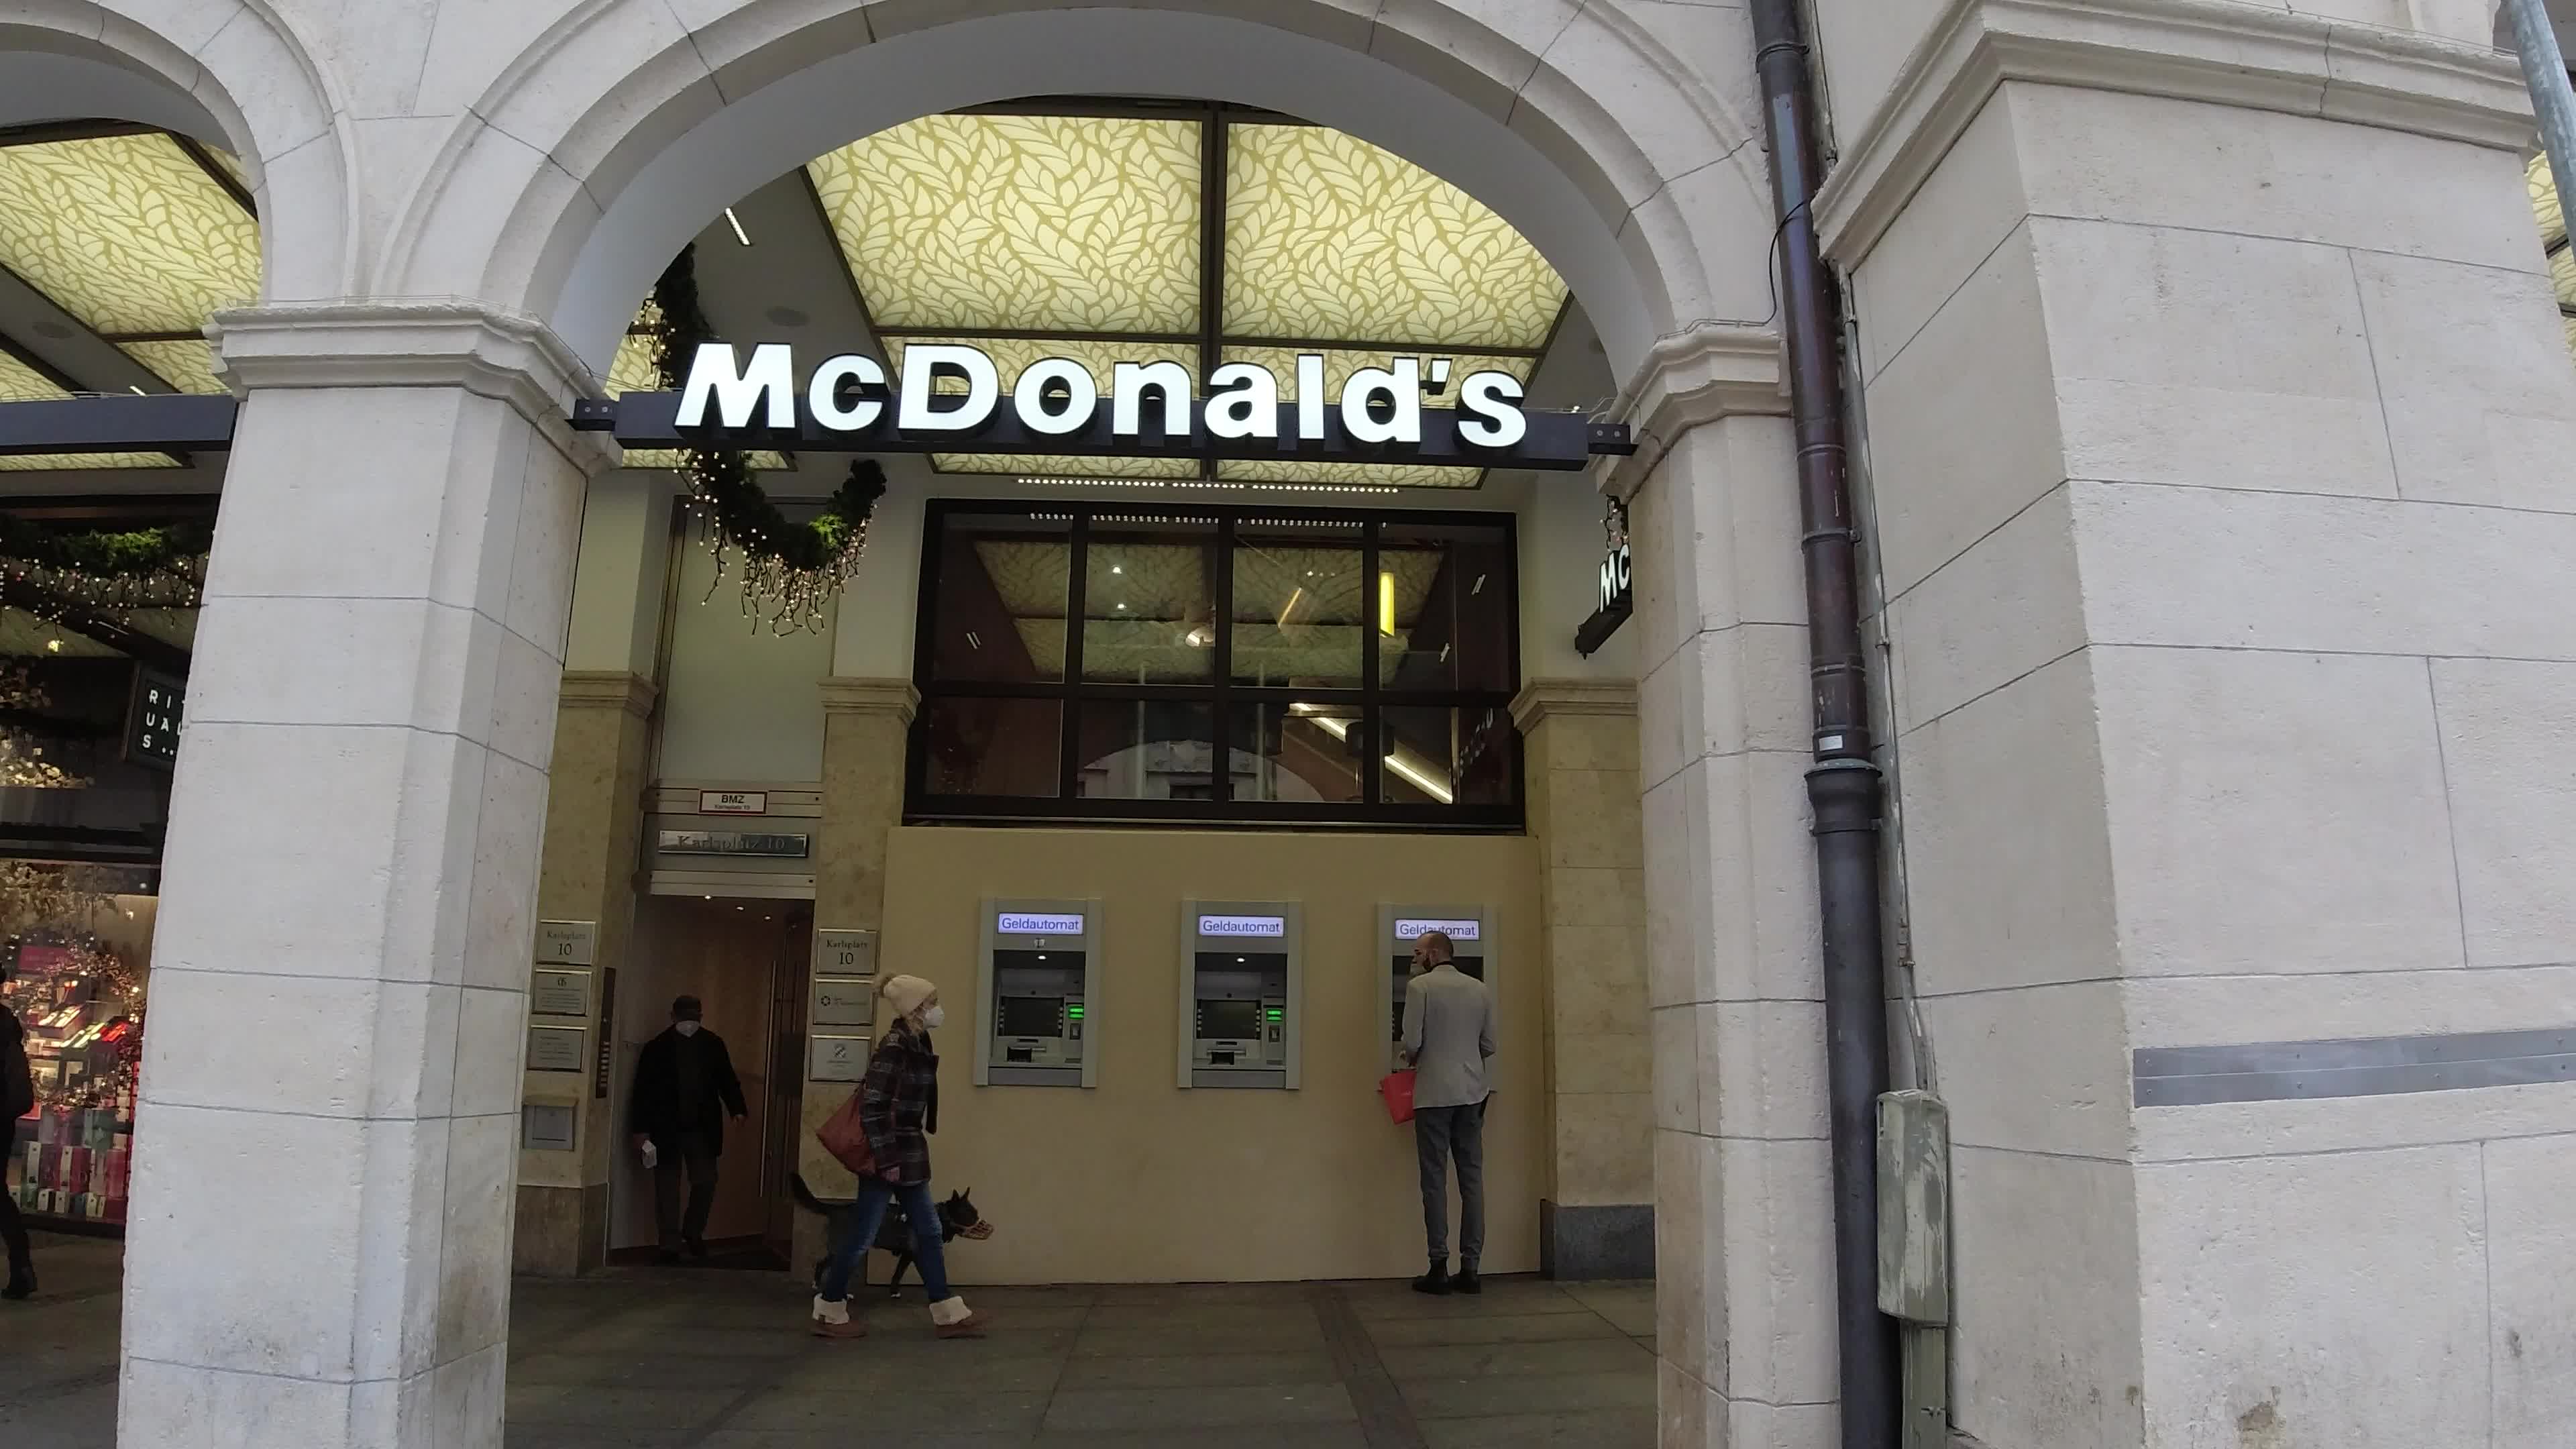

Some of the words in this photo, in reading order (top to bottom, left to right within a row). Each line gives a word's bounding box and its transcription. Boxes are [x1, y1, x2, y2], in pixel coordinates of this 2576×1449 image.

[675, 342, 1527, 447] McDonald's
[149, 689, 185, 708] RI
[721, 794, 745, 804] BMZ
[769, 837, 785, 849] 10
[1002, 917, 1079, 930] Geldautomat
[1203, 920, 1280, 932] Geldautomat
[557, 943, 572, 955] 10
[840, 952, 854, 965] 10
